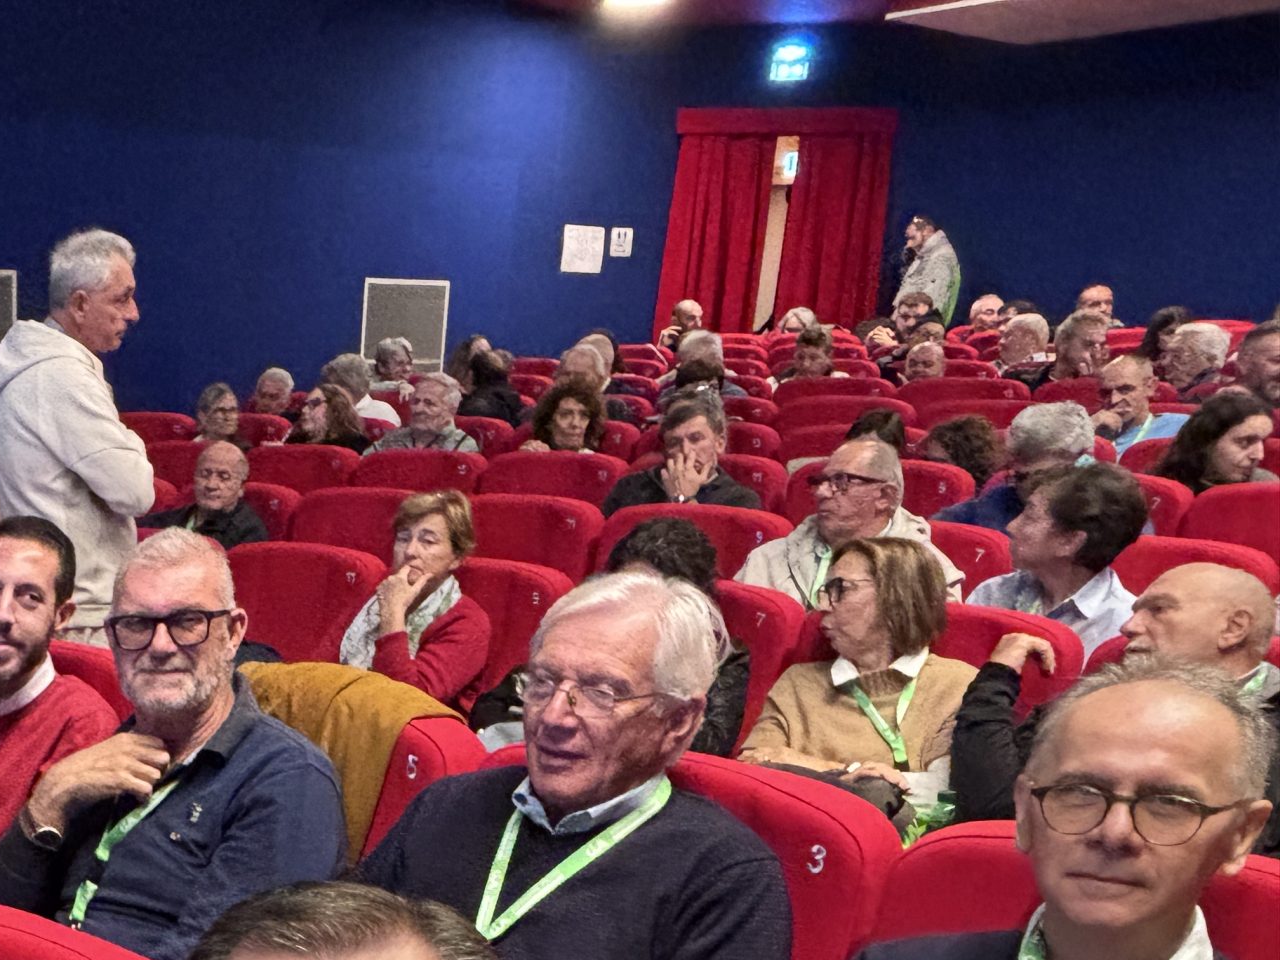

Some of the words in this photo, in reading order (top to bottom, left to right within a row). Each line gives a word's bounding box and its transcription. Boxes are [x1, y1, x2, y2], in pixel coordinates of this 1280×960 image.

[973, 547, 986, 563] 7
[755, 611, 766, 628] 7
[406, 753, 419, 780] 5
[806, 844, 827, 874] 3
